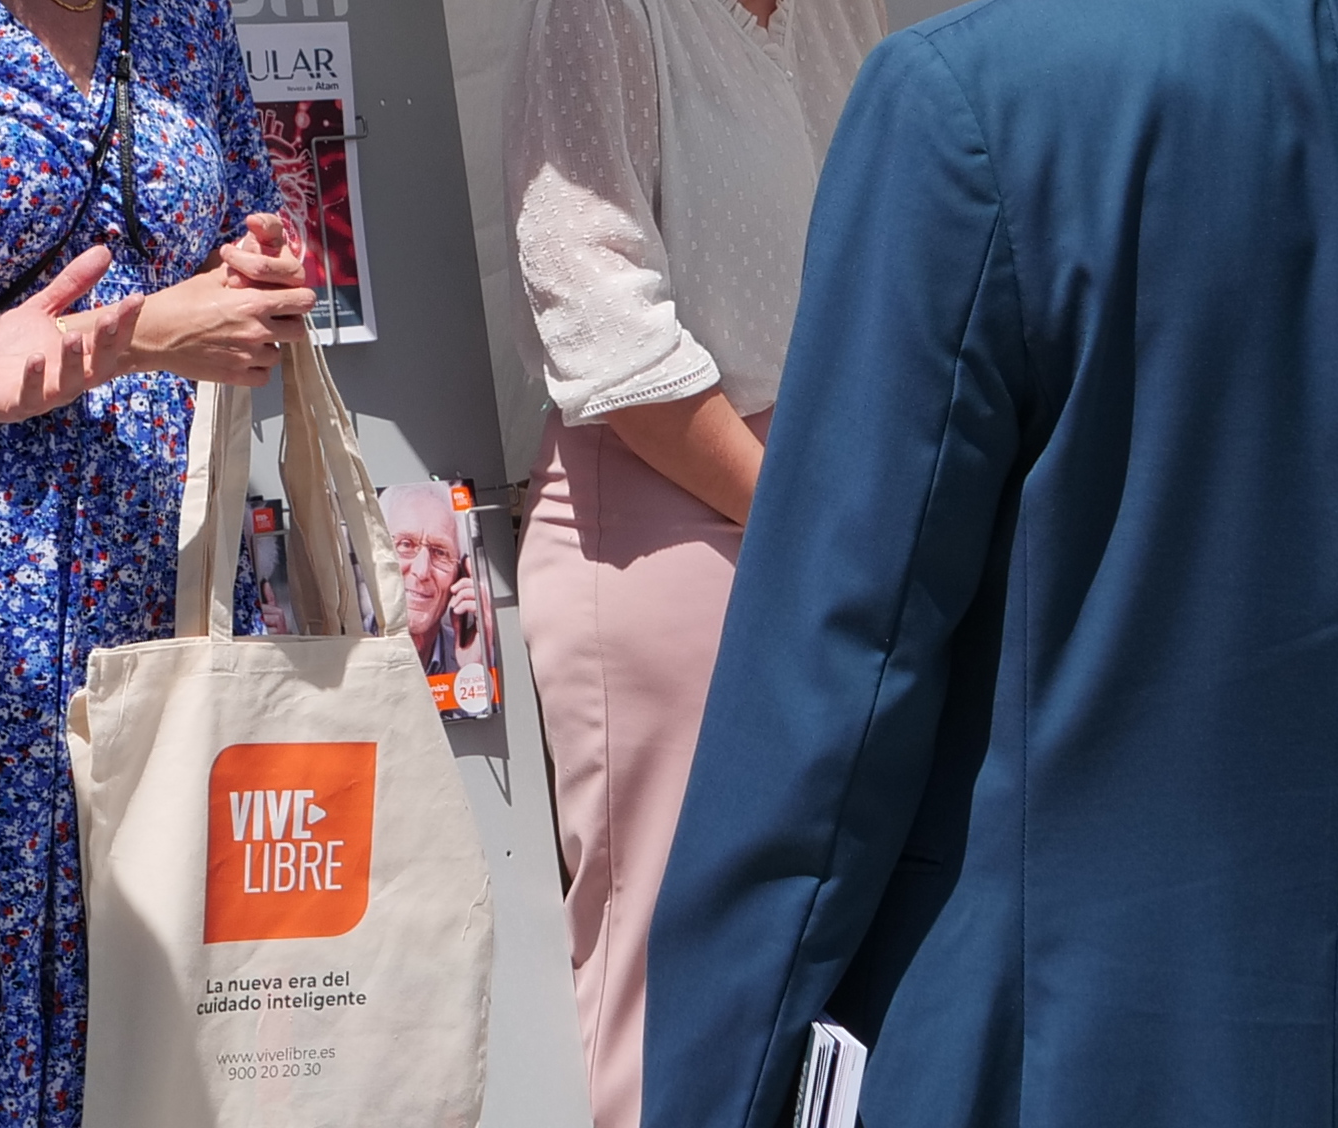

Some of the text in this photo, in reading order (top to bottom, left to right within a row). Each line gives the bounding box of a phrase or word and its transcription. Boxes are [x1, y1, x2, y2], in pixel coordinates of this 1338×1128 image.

[314, 80, 340, 91] Atam
[229, 789, 315, 842] VIVE
[243, 840, 344, 895] LIBRE
[206, 970, 350, 994] La nueva era del
[196, 990, 367, 1016] cuidado inteligente
[216, 1046, 336, 1066] www.vivelibre.es
[228, 1062, 322, 1081] 900 20 20 30
